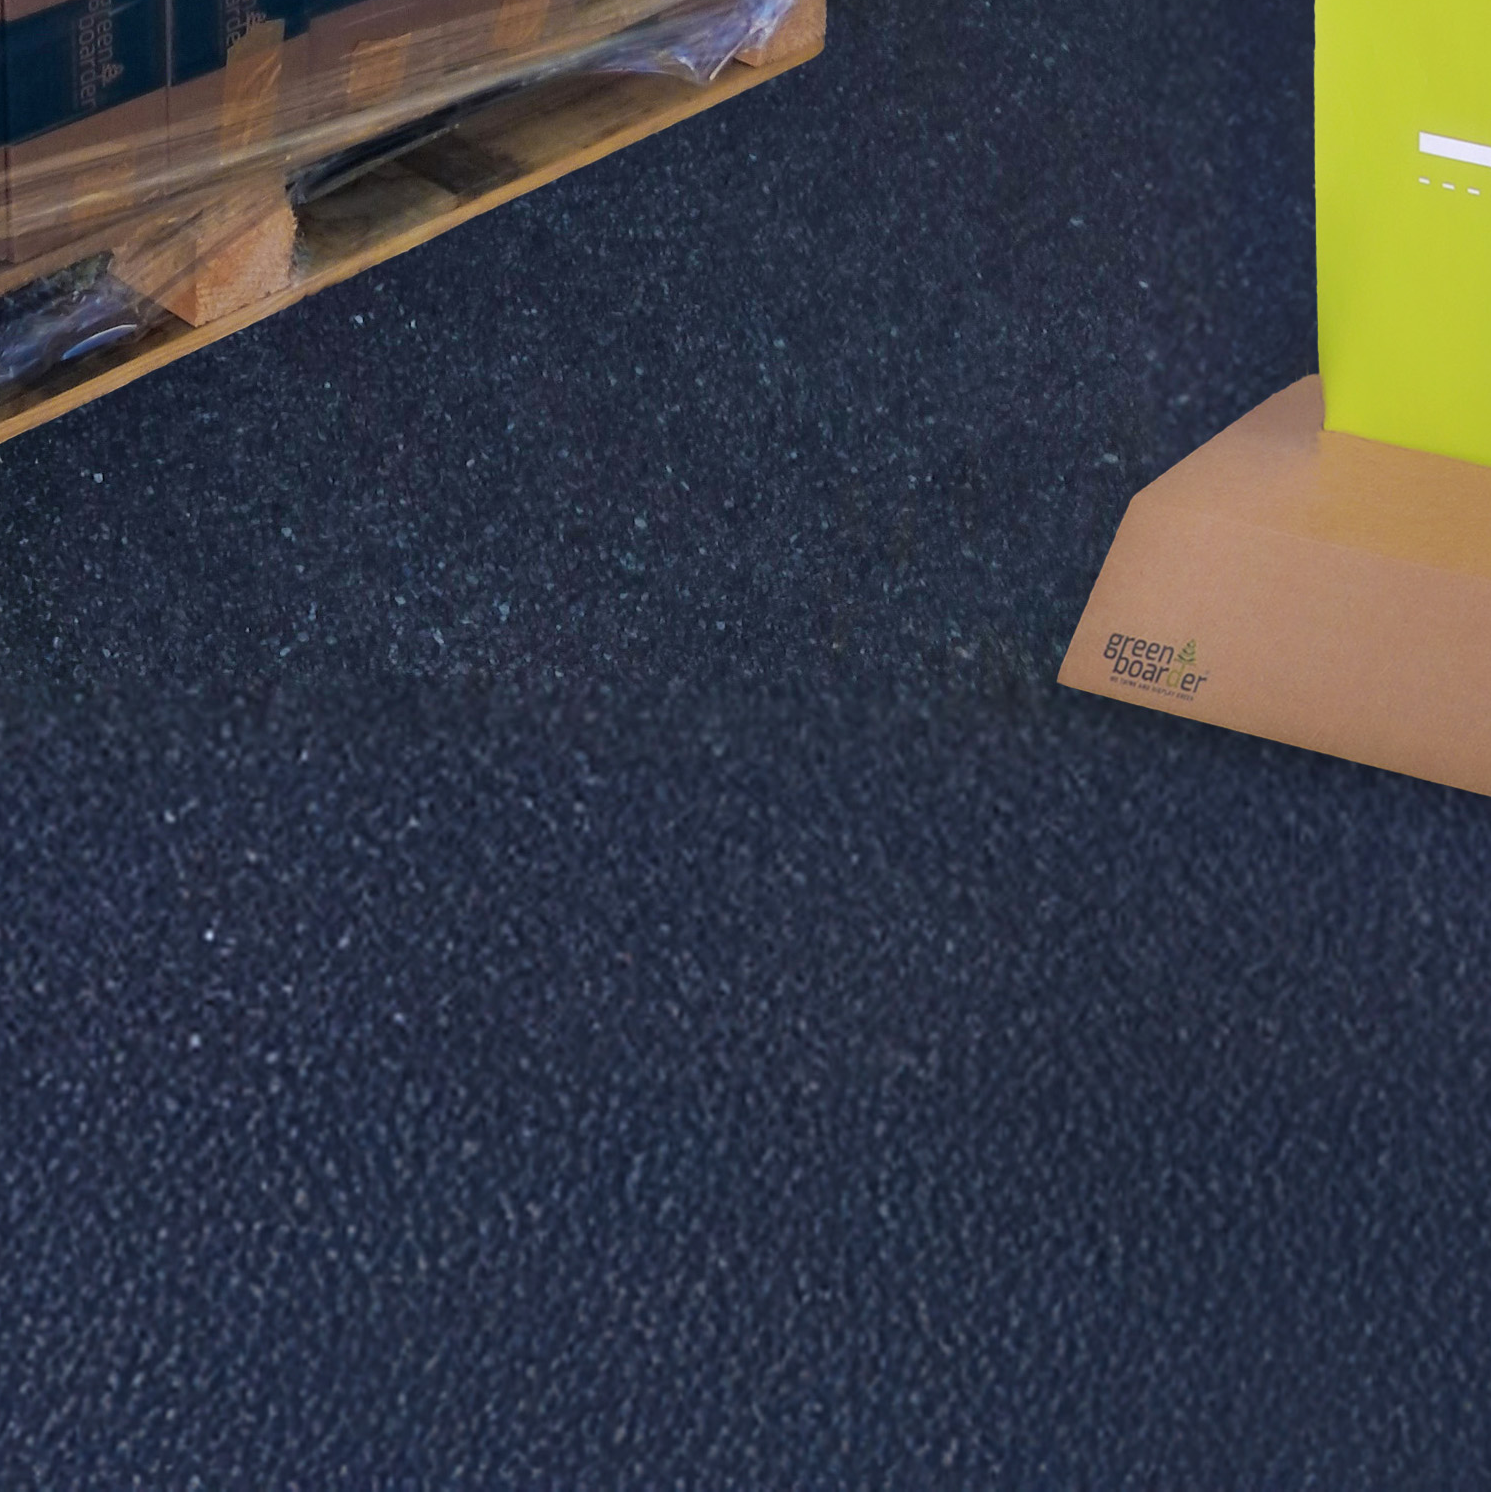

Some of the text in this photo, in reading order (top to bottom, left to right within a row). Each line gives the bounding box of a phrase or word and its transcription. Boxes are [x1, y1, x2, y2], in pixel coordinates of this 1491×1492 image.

[78, 16, 97, 108] boarder
[1103, 632, 1175, 664] green
[1113, 654, 1207, 693] boarder
